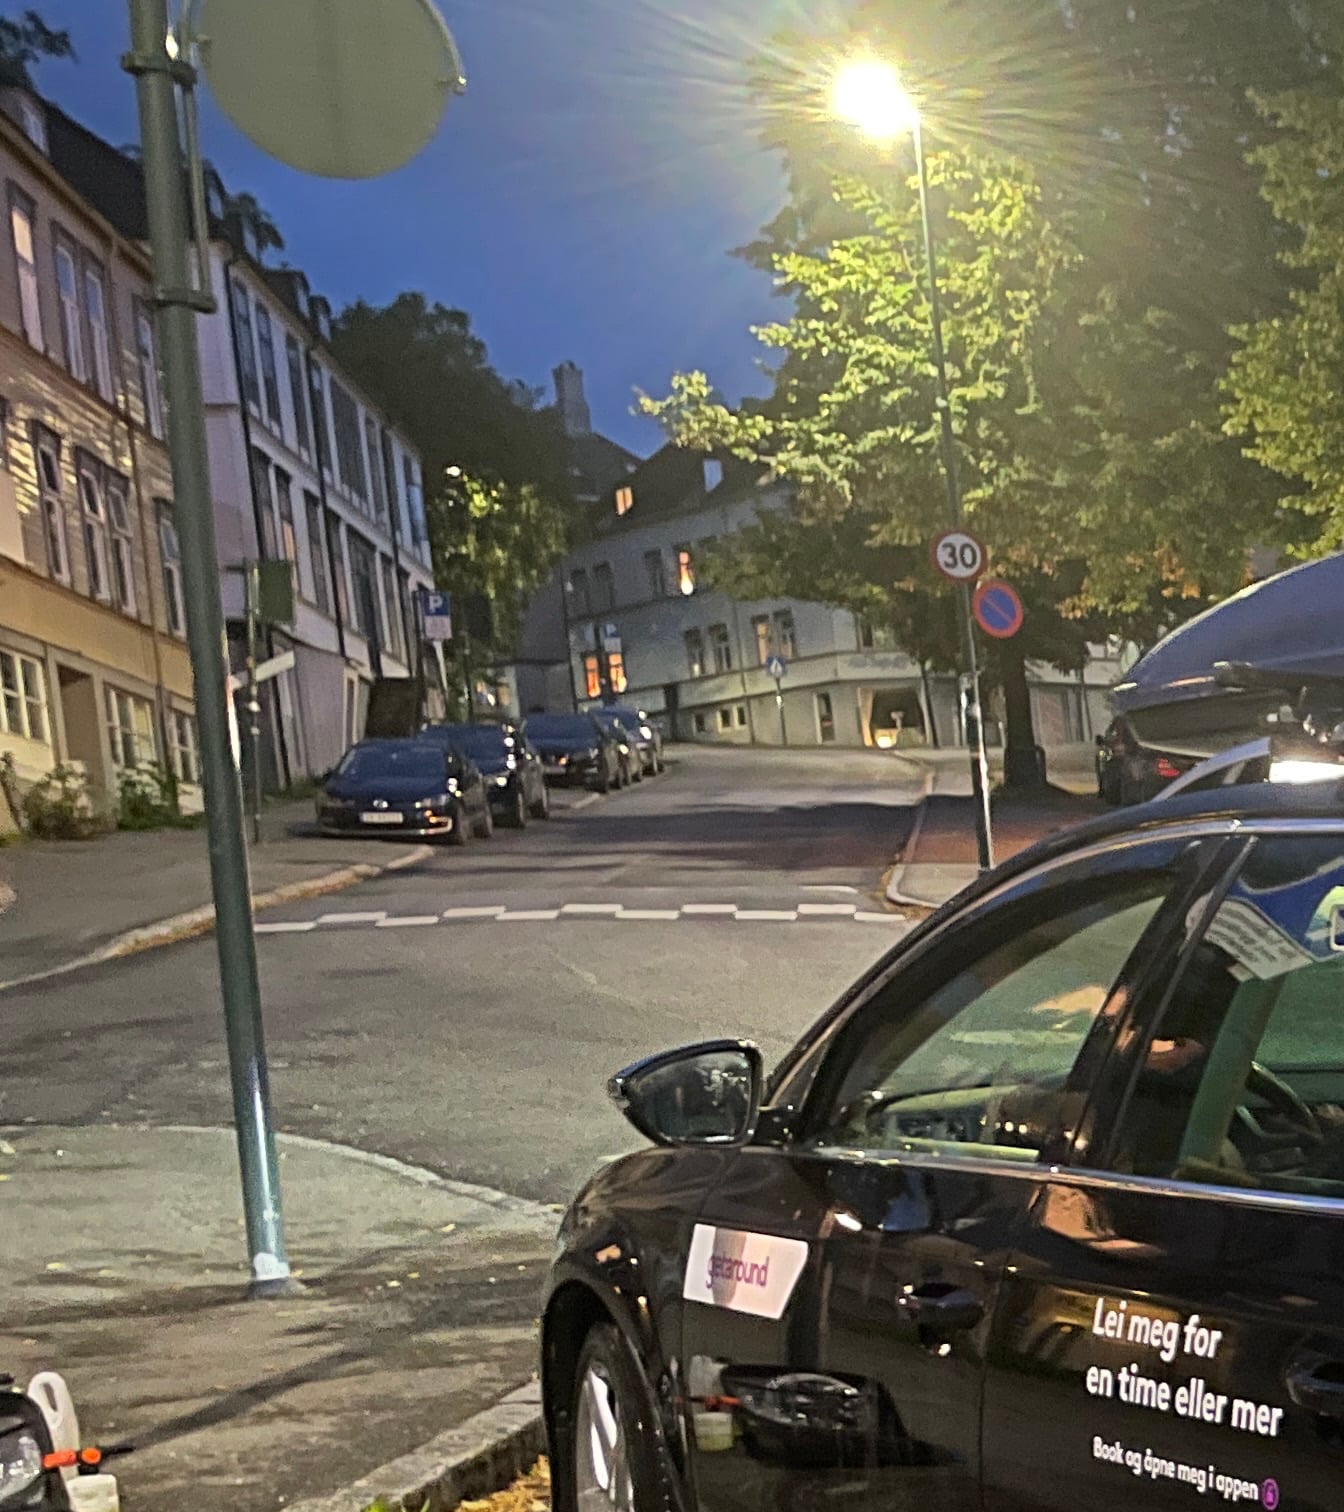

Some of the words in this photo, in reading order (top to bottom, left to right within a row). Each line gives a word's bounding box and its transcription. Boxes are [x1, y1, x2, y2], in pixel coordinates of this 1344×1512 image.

[942, 542, 978, 569] 30
[428, 595, 443, 613] P
[1092, 1297, 1127, 1339] Lei
[1127, 1314, 1180, 1362] meg
[1183, 1314, 1223, 1358] for
[1086, 1365, 1114, 1397] en
[1117, 1363, 1171, 1411] time
[1174, 1377, 1228, 1423] eller
[1231, 1398, 1283, 1437] mer
[1093, 1436, 1124, 1464] Book
[1125, 1450, 1142, 1476] og
[1143, 1448, 1176, 1479] åpne
[1177, 1463, 1206, 1493] meg
[1208, 1465, 1214, 1488] i
[1215, 1475, 1260, 1502] appen
